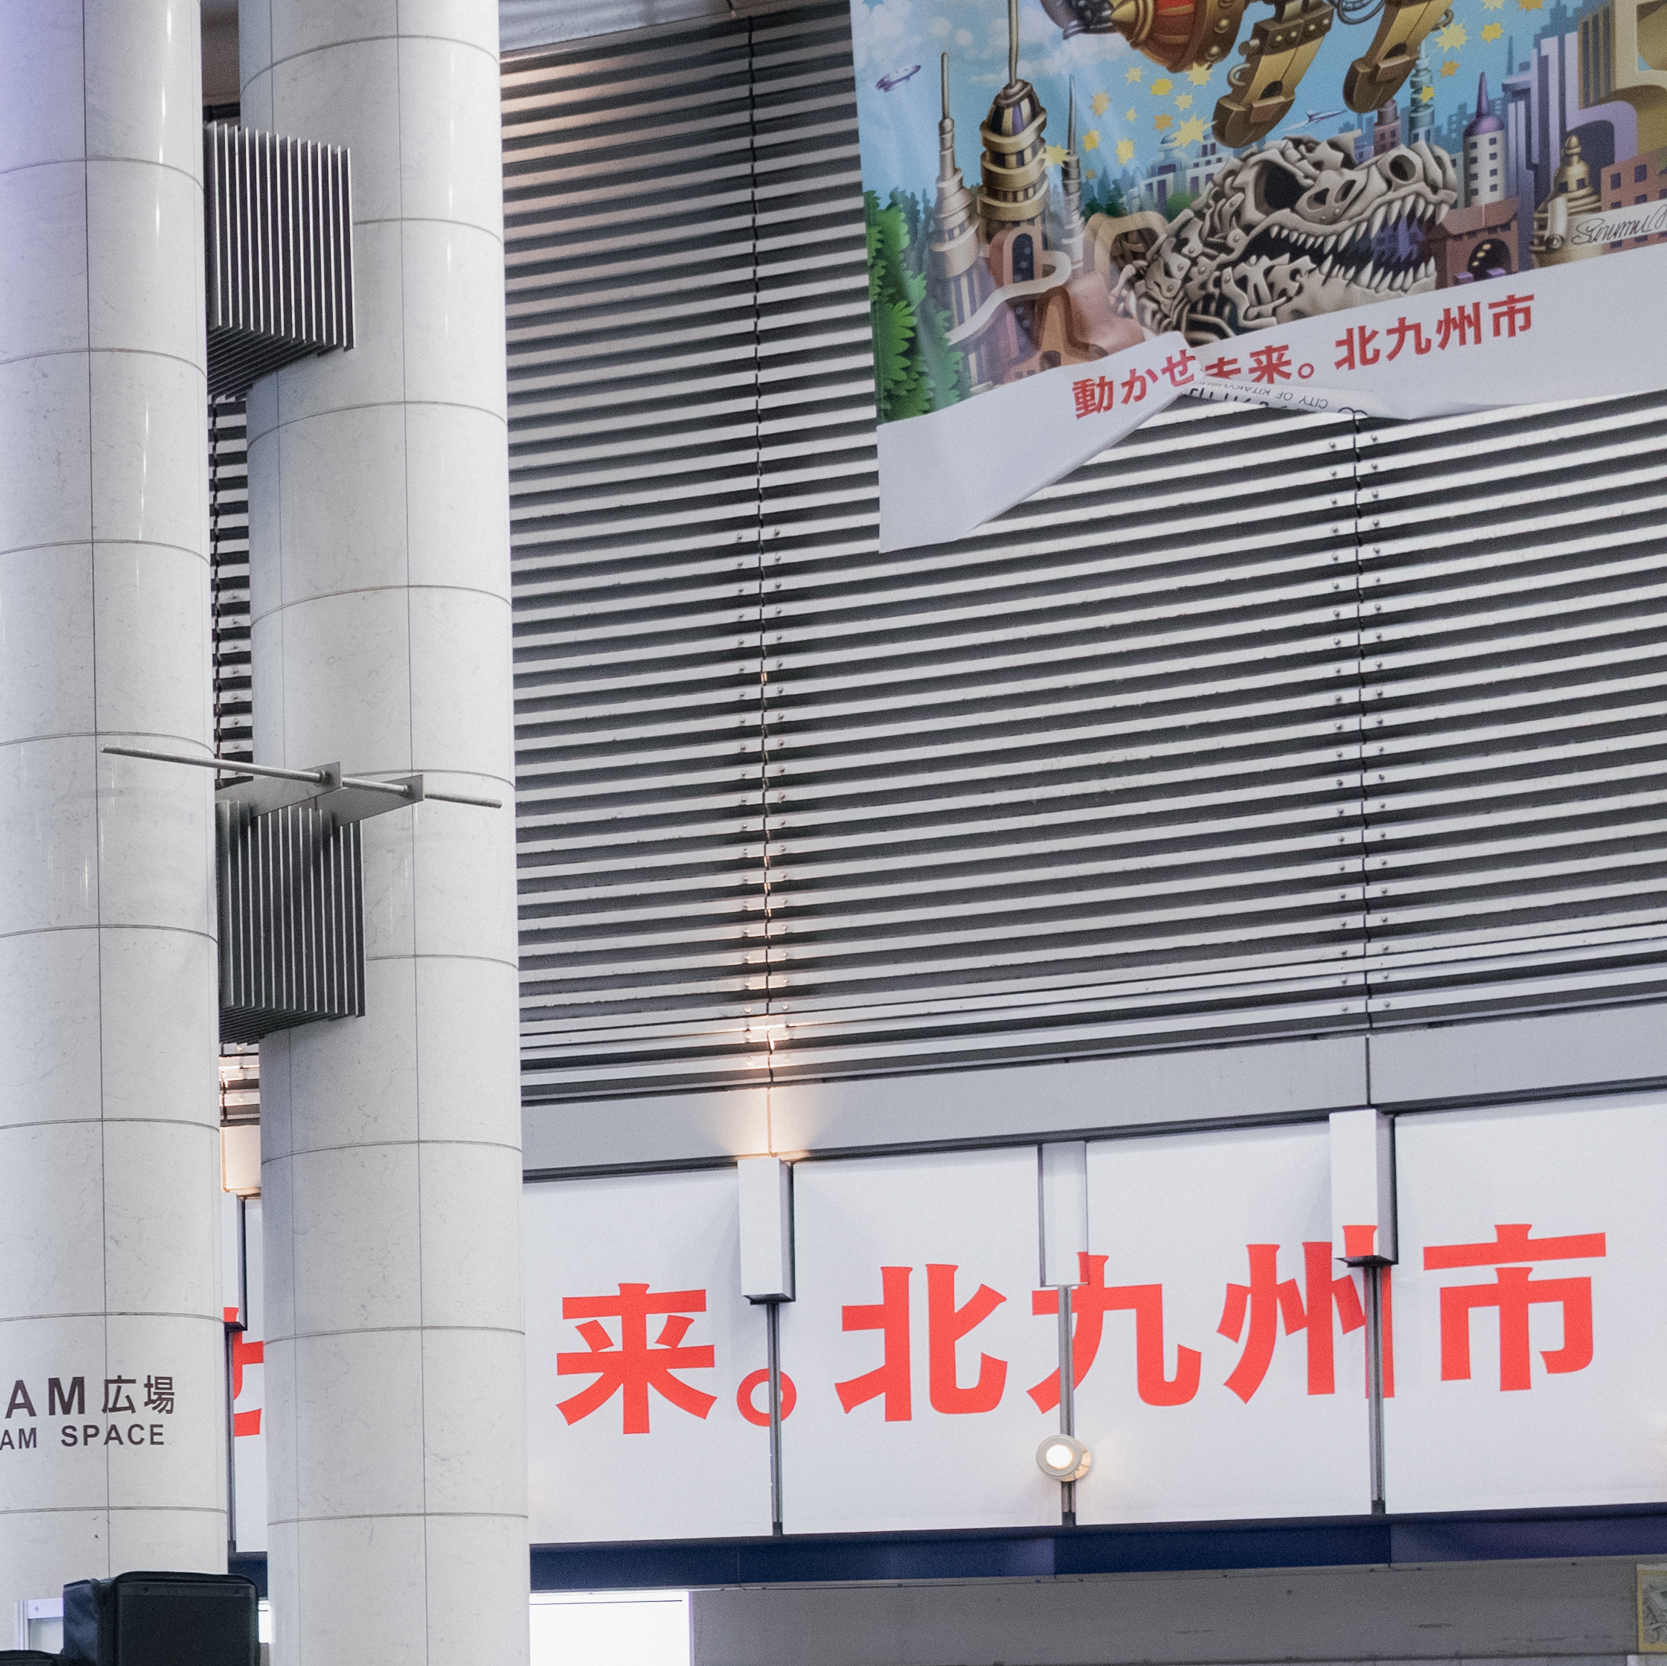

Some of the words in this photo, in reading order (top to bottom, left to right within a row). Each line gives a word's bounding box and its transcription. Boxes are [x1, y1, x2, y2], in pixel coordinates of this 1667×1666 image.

[1072, 294, 1537, 421] 動かせ未来。北九州市
[1274, 390, 1294, 402] OF
[1298, 394, 1329, 410] CITY
[101, 1374, 176, 1416] 広場
[60, 1423, 165, 1448] SPACE
